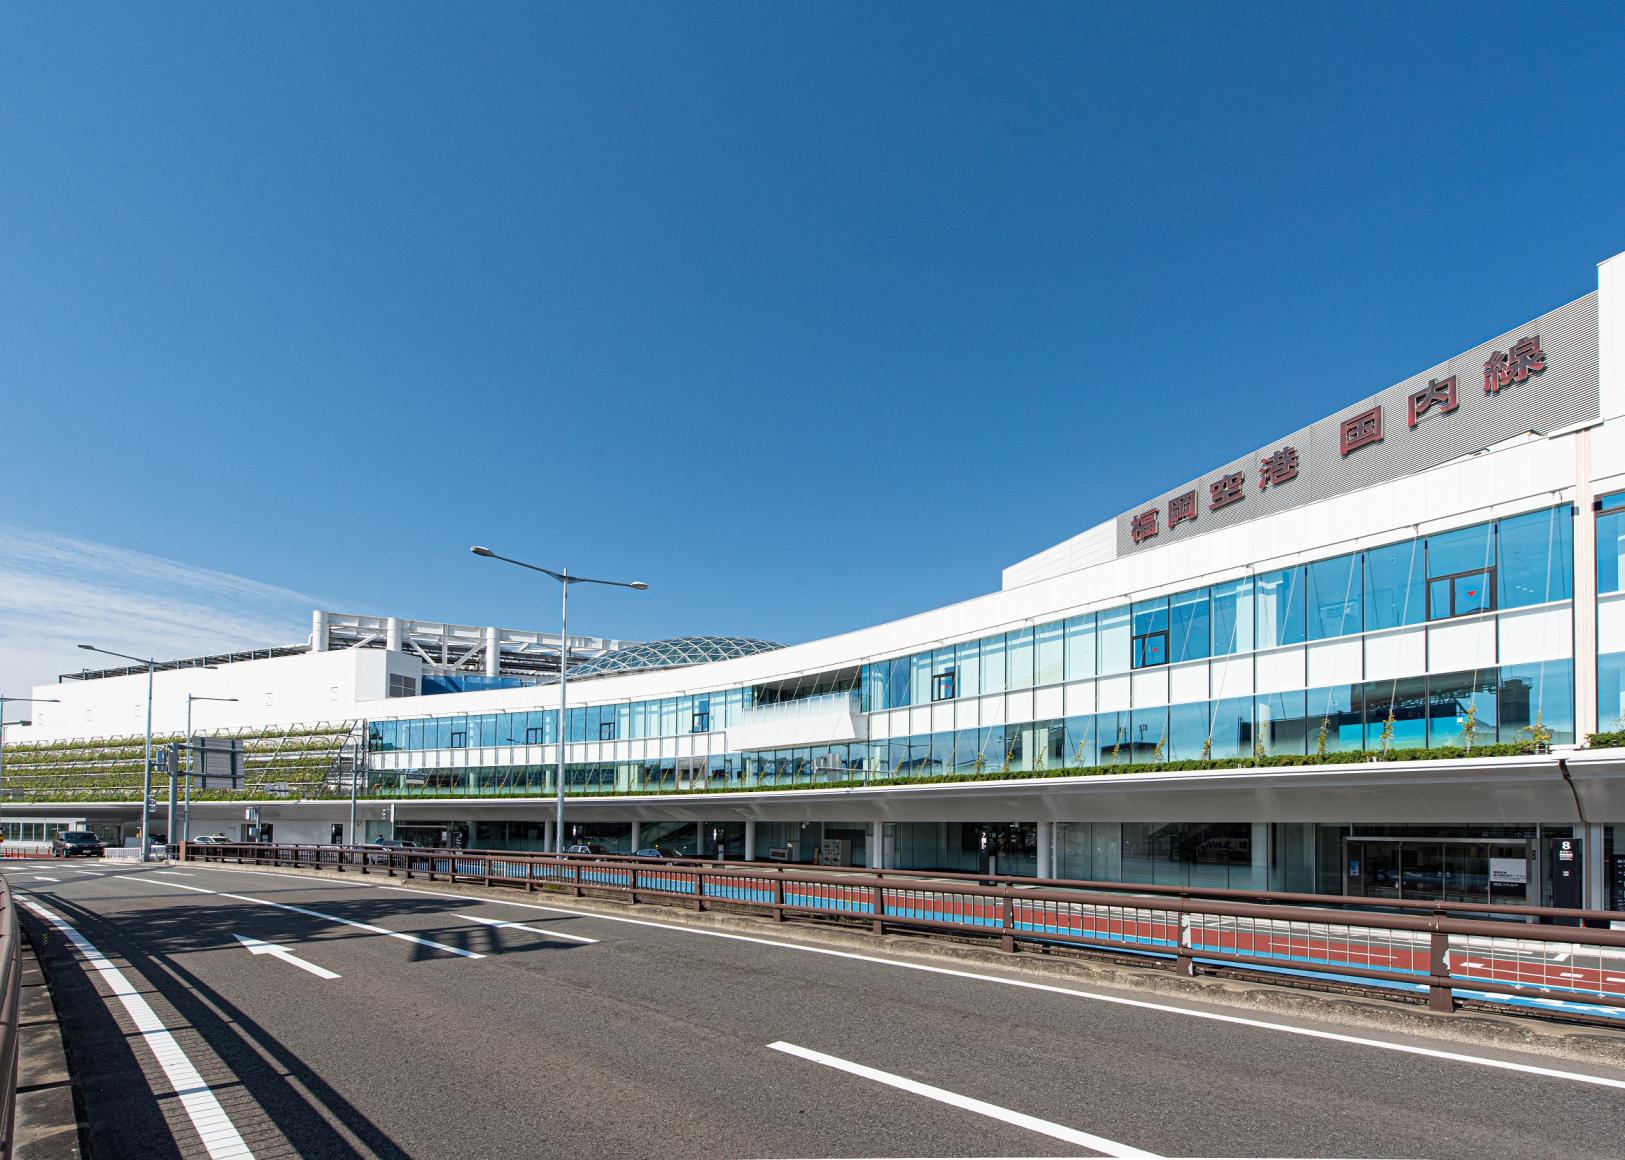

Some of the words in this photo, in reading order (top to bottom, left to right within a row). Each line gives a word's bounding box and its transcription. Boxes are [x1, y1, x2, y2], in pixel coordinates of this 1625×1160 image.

[1131, 446, 1299, 543] 福岡空港
[1340, 334, 1547, 456] 国内線
[1562, 841, 1571, 850] 8
